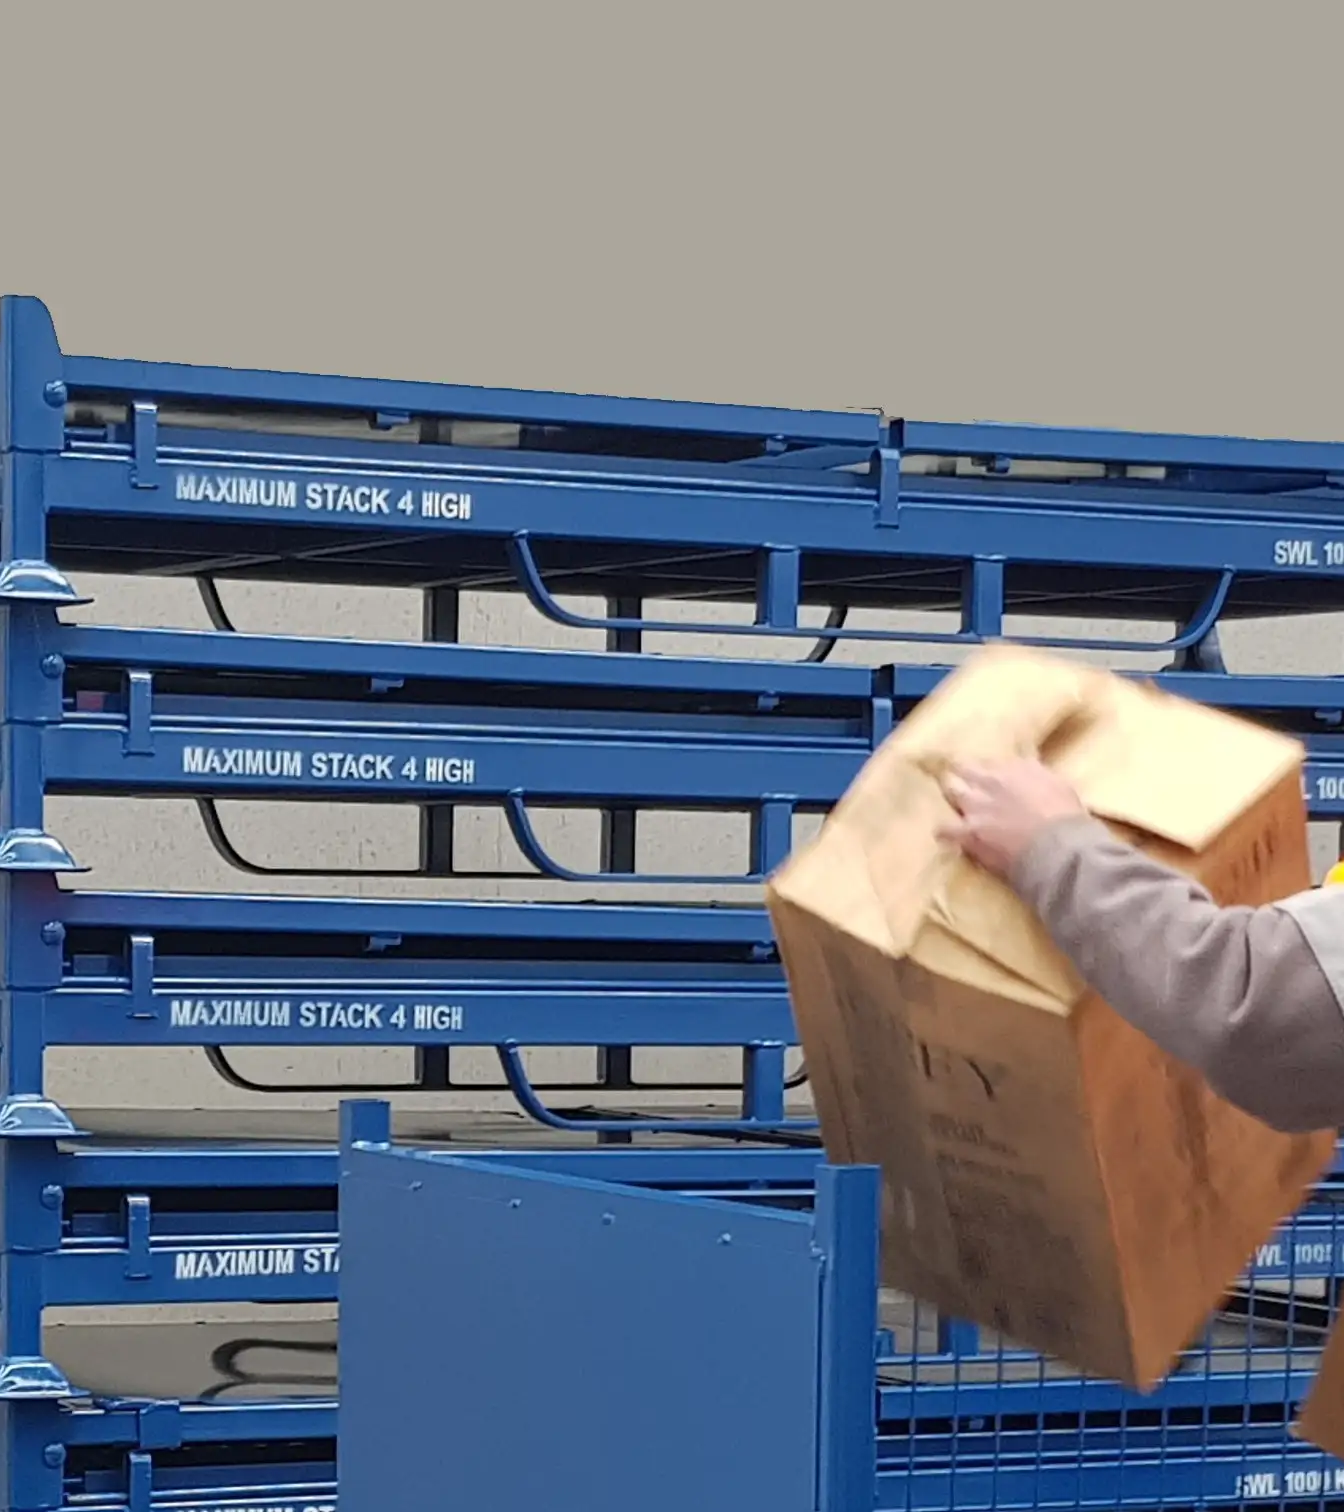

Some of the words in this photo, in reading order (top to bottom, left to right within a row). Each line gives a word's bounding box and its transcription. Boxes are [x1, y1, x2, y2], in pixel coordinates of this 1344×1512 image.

[176, 473, 297, 508] MAXIMUM
[306, 483, 391, 514] STACK
[397, 490, 414, 516] 4
[422, 490, 472, 520] HIGH
[1274, 540, 1319, 565] SWL
[183, 746, 302, 777] MAXIMUM
[311, 752, 396, 780] STACK
[401, 755, 417, 781] 4
[425, 757, 474, 784] HIGH
[170, 1000, 290, 1027] MAXIMUM
[299, 1002, 383, 1029] STACK
[389, 1004, 406, 1029] 4
[413, 1005, 463, 1030] HIGH
[175, 1249, 295, 1280] MAXIMUM
